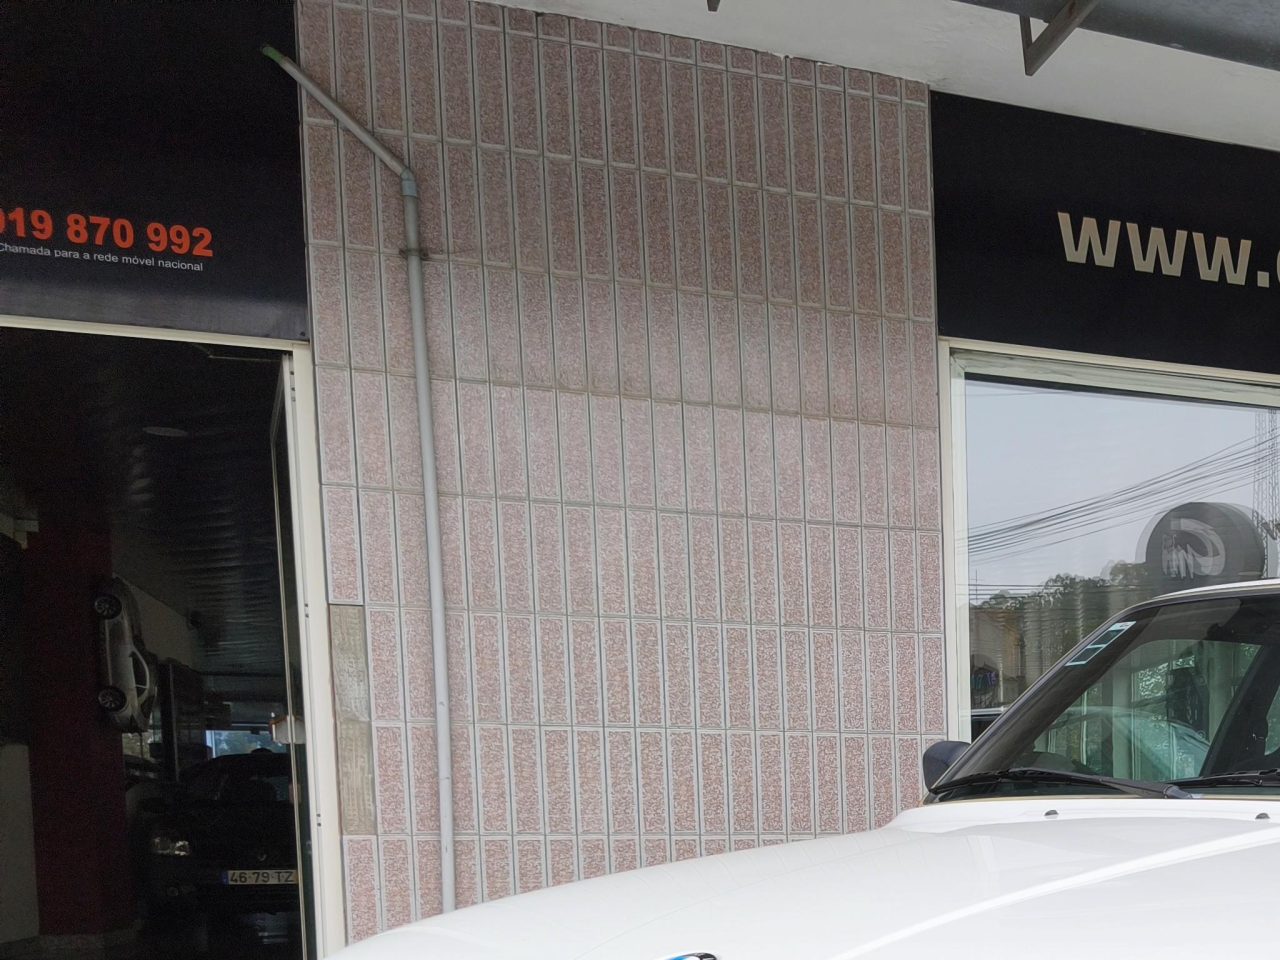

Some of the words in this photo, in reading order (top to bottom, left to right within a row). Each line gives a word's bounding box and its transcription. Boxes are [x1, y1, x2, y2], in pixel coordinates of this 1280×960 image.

[0, 207, 53, 240] 19
[66, 213, 134, 249] 870
[147, 222, 214, 257] 992
[54, 249, 80, 260] para
[83, 252, 90, 260] a
[94, 252, 119, 263] rede
[122, 254, 155, 266] móvel
[158, 260, 204, 272] nacional
